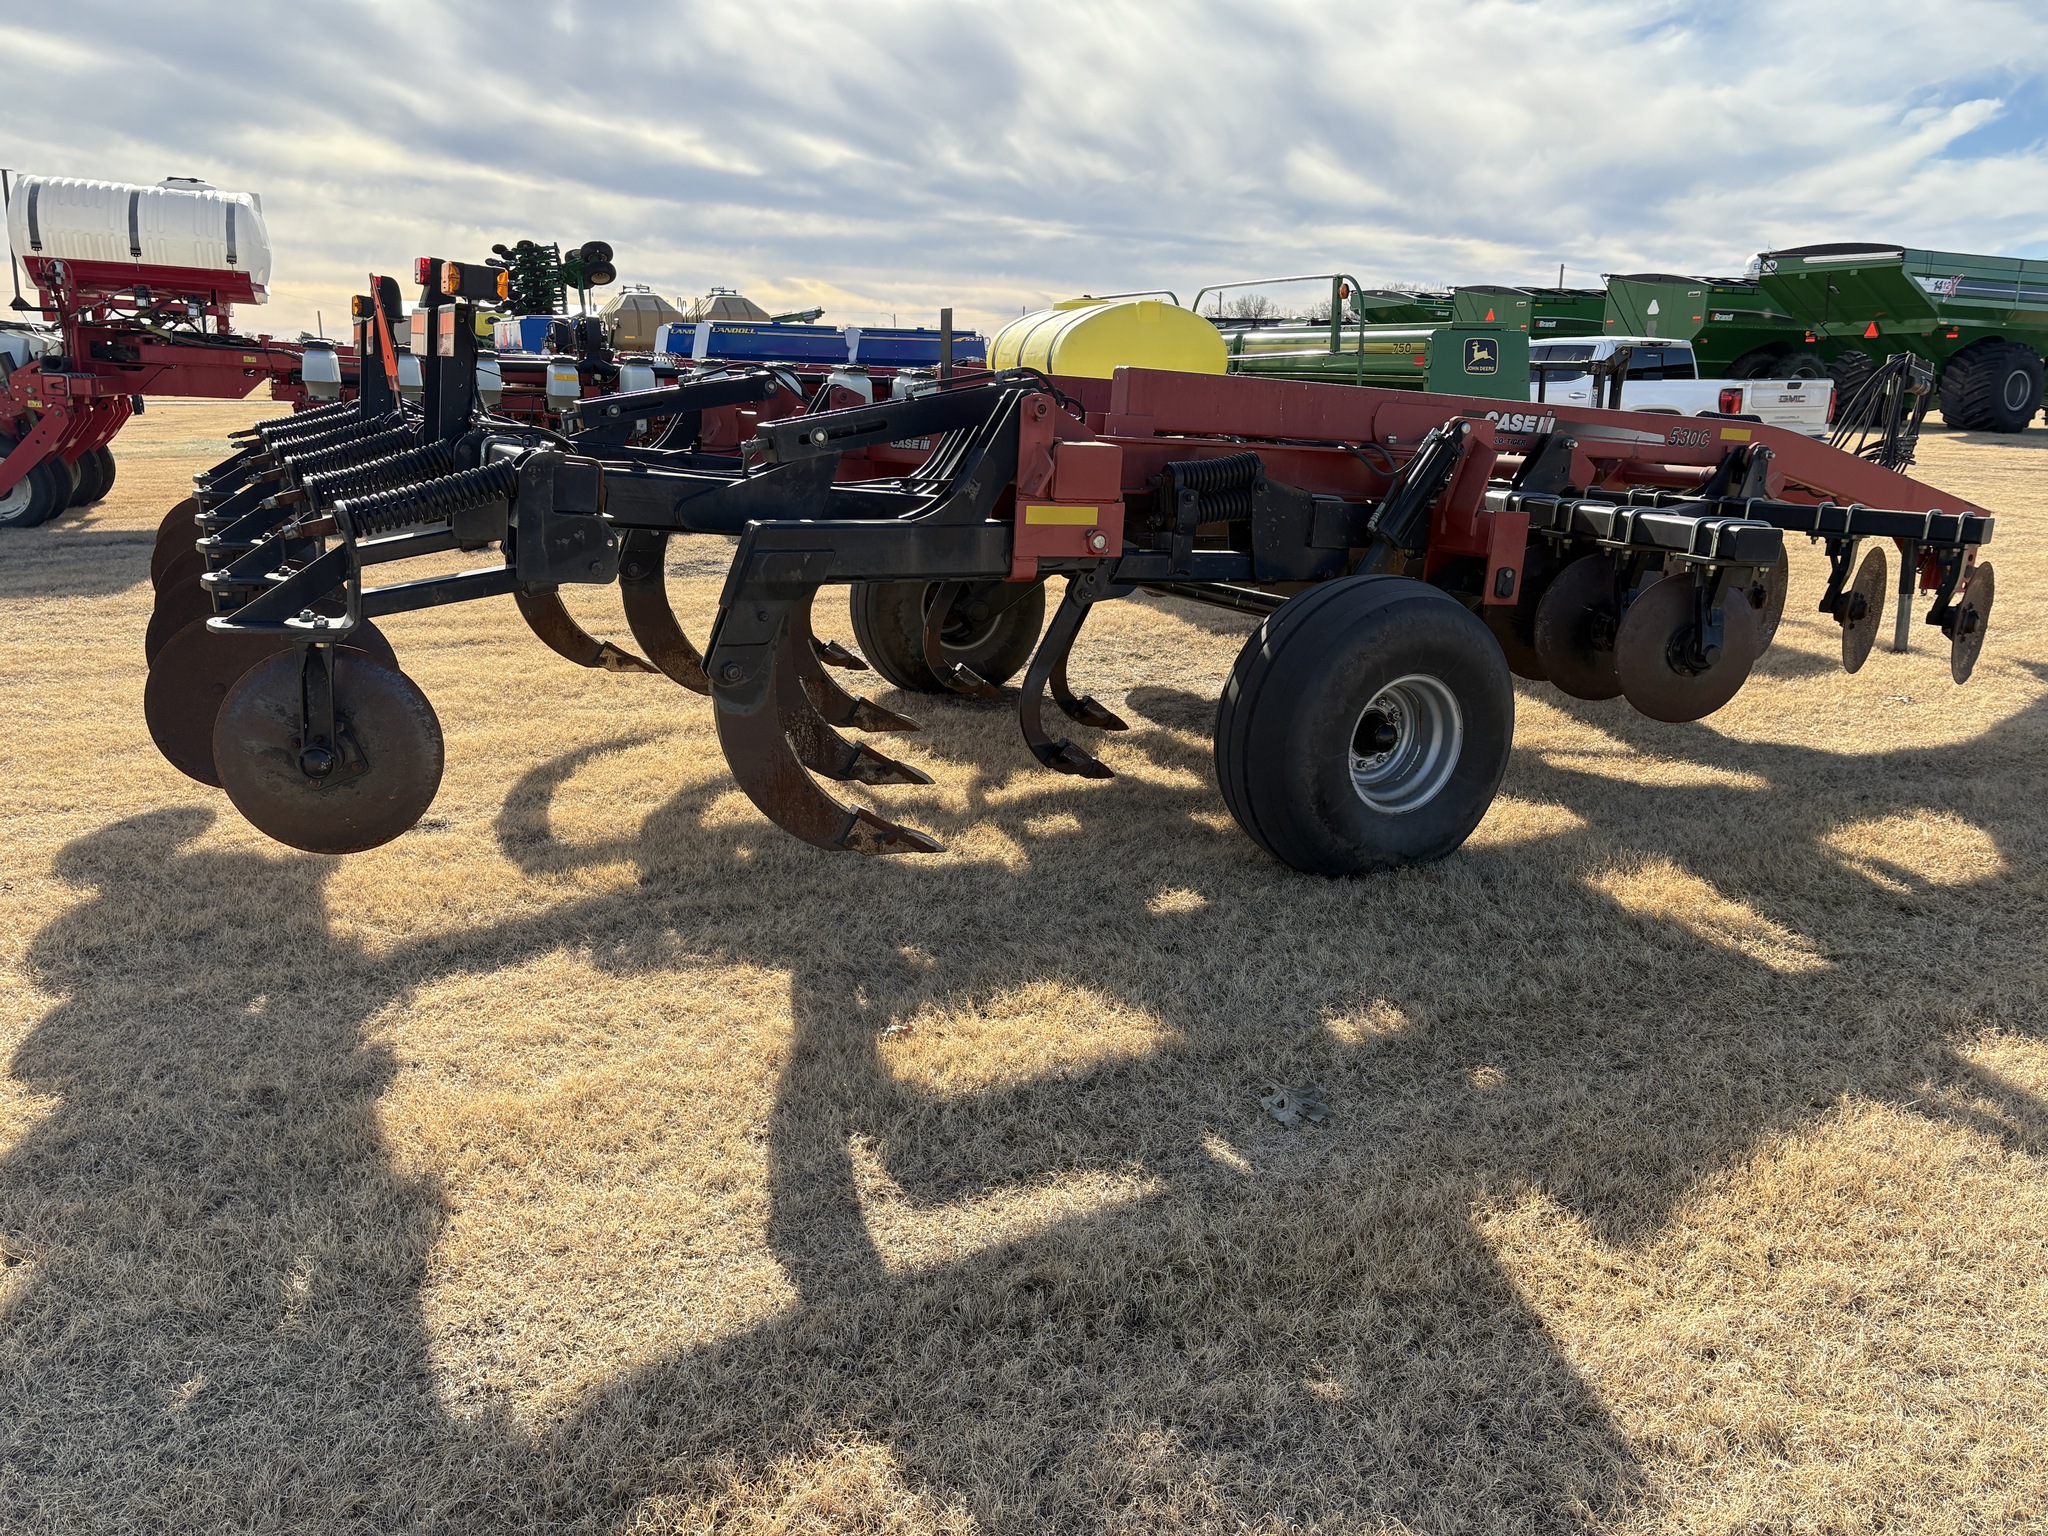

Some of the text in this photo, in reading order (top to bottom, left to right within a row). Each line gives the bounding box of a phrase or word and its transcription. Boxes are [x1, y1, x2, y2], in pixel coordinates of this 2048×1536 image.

[1714, 312, 1735, 322] Brandt
[711, 326, 757, 335] LANDOLL
[1392, 343, 1412, 354] 750
[1778, 395, 1806, 403] GMC
[1667, 426, 1712, 449] 530C
[890, 438, 920, 450] CASE
